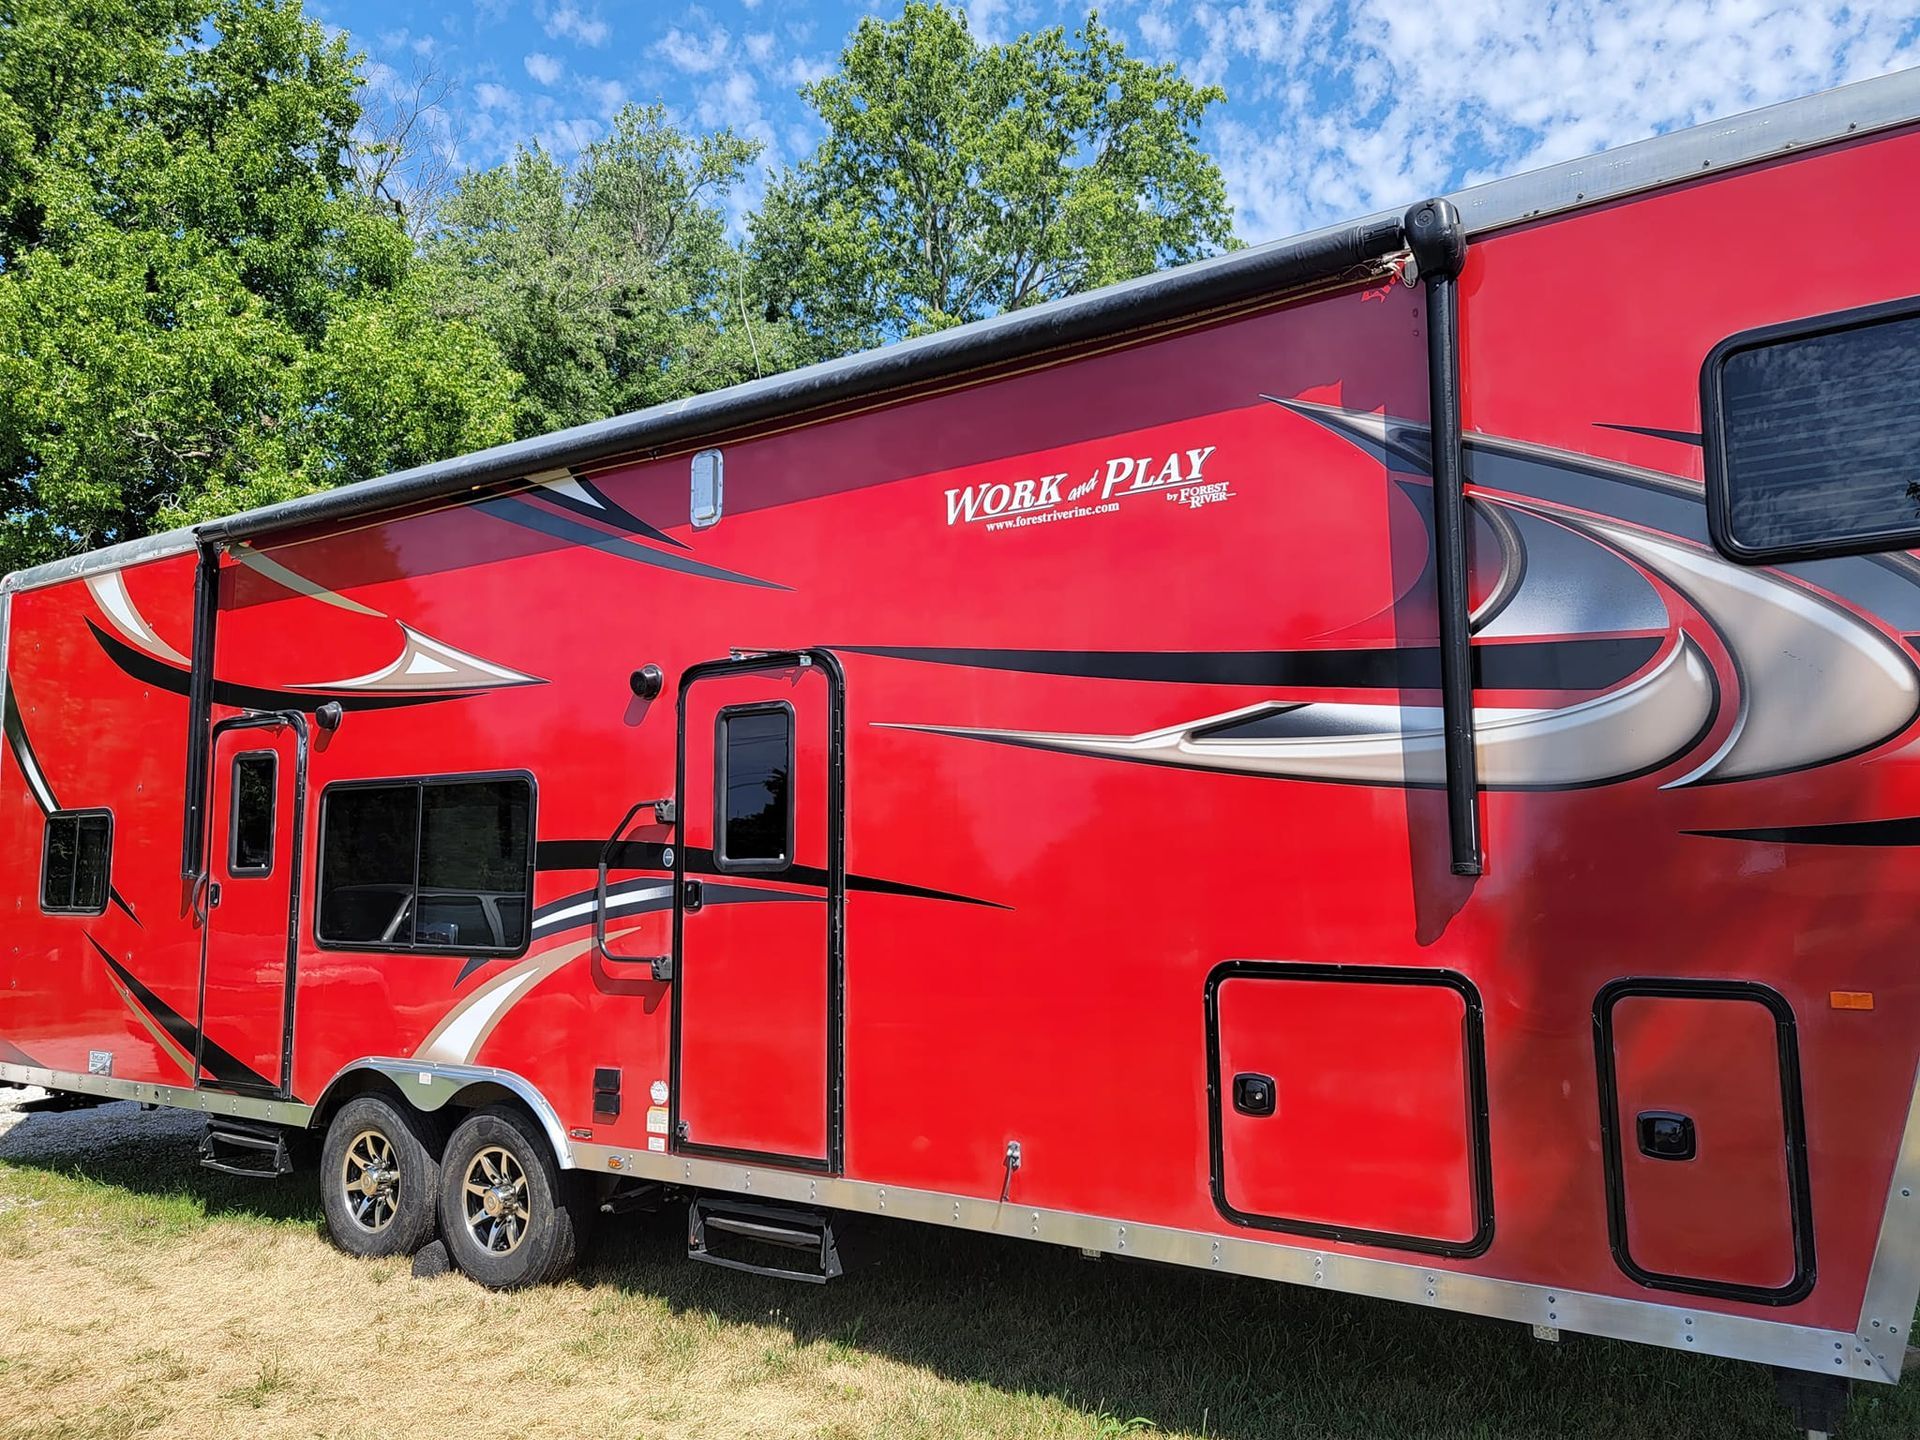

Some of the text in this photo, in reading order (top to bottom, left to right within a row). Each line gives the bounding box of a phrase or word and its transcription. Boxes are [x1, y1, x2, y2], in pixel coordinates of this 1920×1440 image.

[944, 446, 1216, 525] WORK and PLAY
[1166, 482, 1229, 502] by FOREST
[1190, 492, 1227, 509] RIVER
[986, 503, 1120, 532] www.forestriverinc.com
